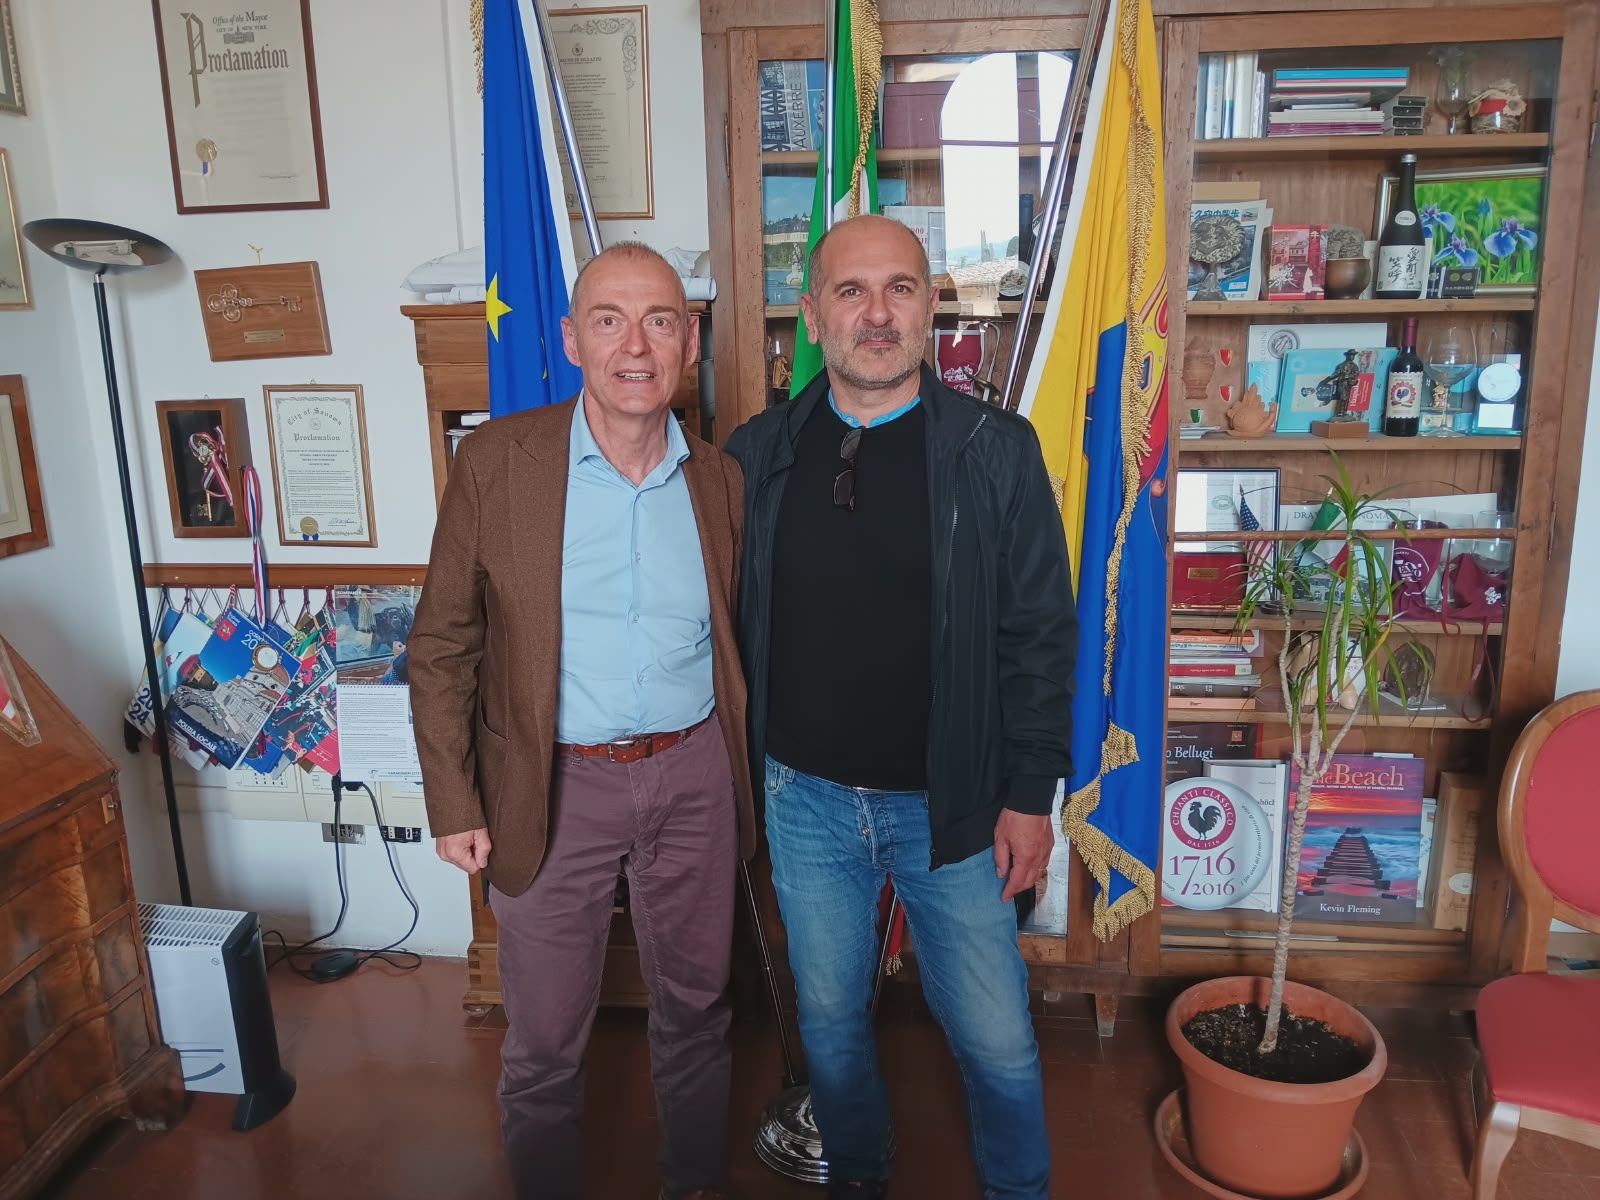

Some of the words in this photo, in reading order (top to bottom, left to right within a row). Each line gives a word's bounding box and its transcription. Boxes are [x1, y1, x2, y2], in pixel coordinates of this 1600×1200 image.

[245, 11, 268, 23] Mayor
[180, 12, 289, 108] Proclamation
[790, 82, 807, 149] AUXERRE
[1358, 512, 1390, 520] NOMA
[241, 633, 258, 650] 20
[128, 702, 150, 726] 24
[177, 718, 197, 736] POLIZIA
[196, 733, 218, 751] LOCALE
[1175, 745, 1214, 762] Bellugi
[1333, 763, 1405, 787] Beach
[1172, 789, 1199, 826] CHIANTI
[1202, 788, 1234, 826] CLASSICO
[1186, 839, 1201, 848] DAL
[1203, 840, 1221, 848] 1716
[1169, 846, 1236, 896] 1716
[1191, 877, 1236, 896] 2016
[1319, 902, 1345, 913] Kevin
[1347, 904, 1381, 916] Fleming
